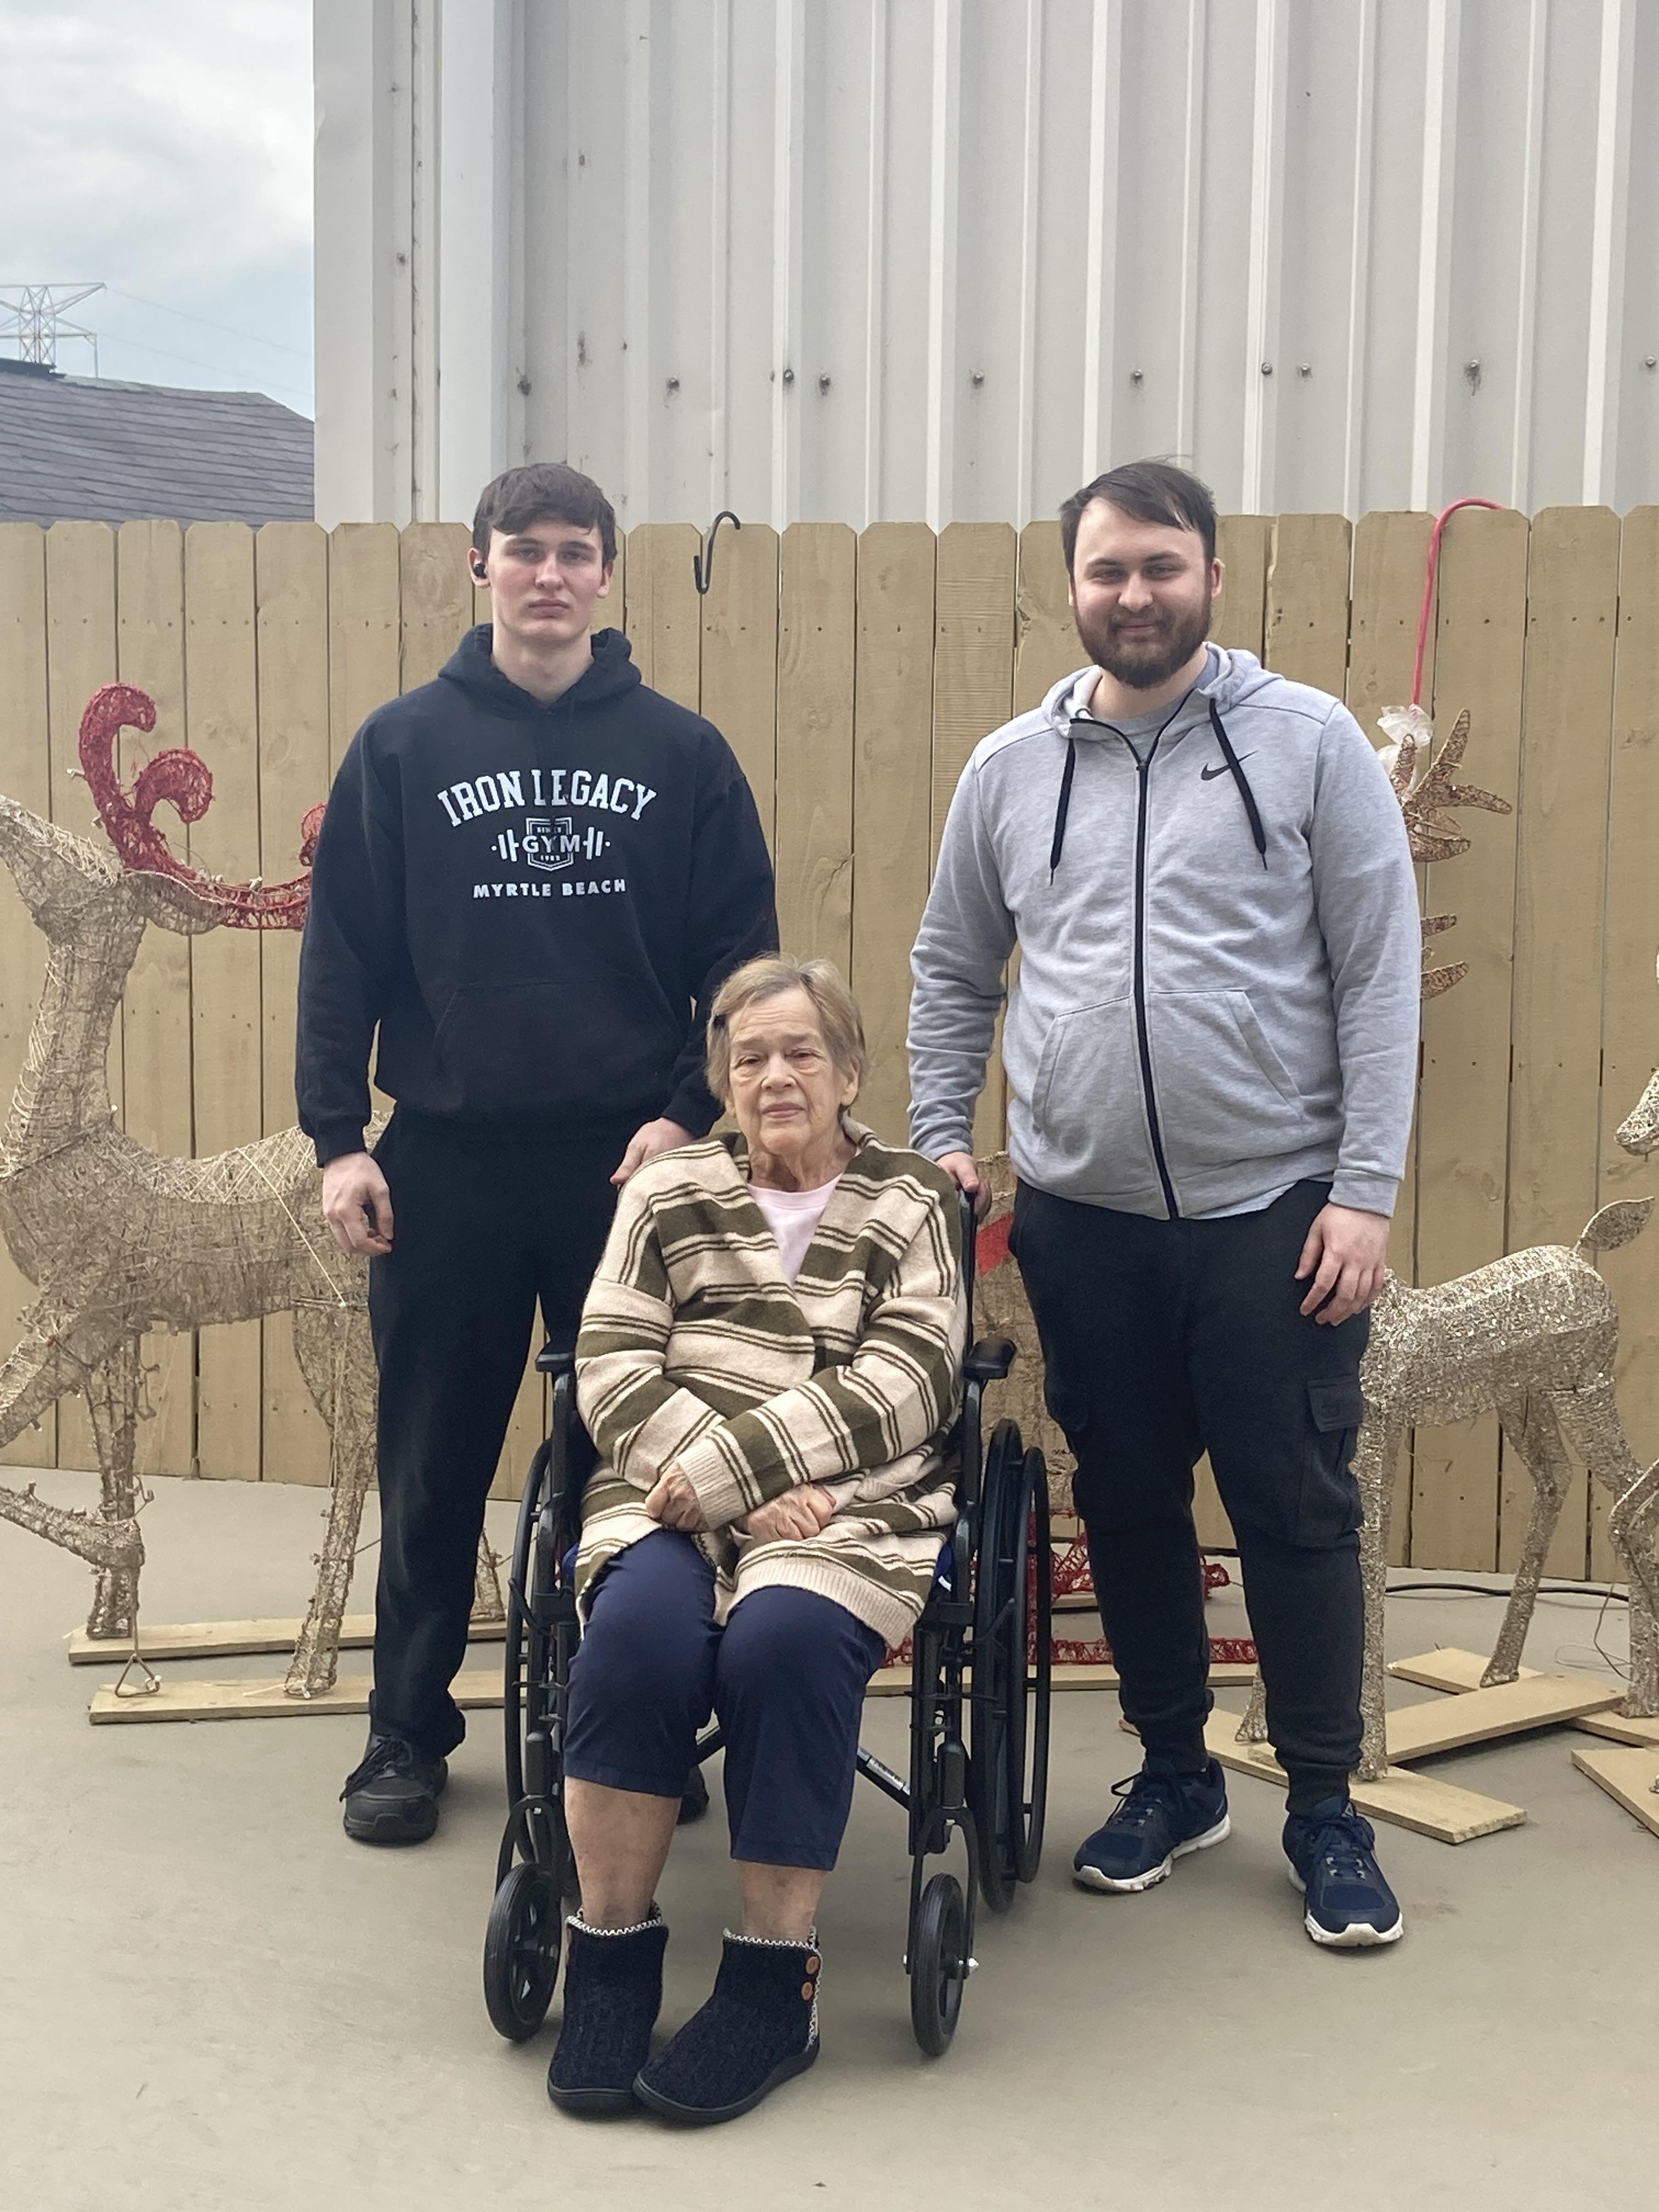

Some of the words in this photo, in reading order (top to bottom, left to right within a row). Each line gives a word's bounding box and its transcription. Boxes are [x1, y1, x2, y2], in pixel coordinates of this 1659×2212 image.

[437, 770, 525, 827] IRON
[531, 769, 657, 821] LEGACY
[522, 834, 580, 853] GYM
[473, 883, 551, 898] MYRTLE
[562, 878, 626, 896] BEACH
